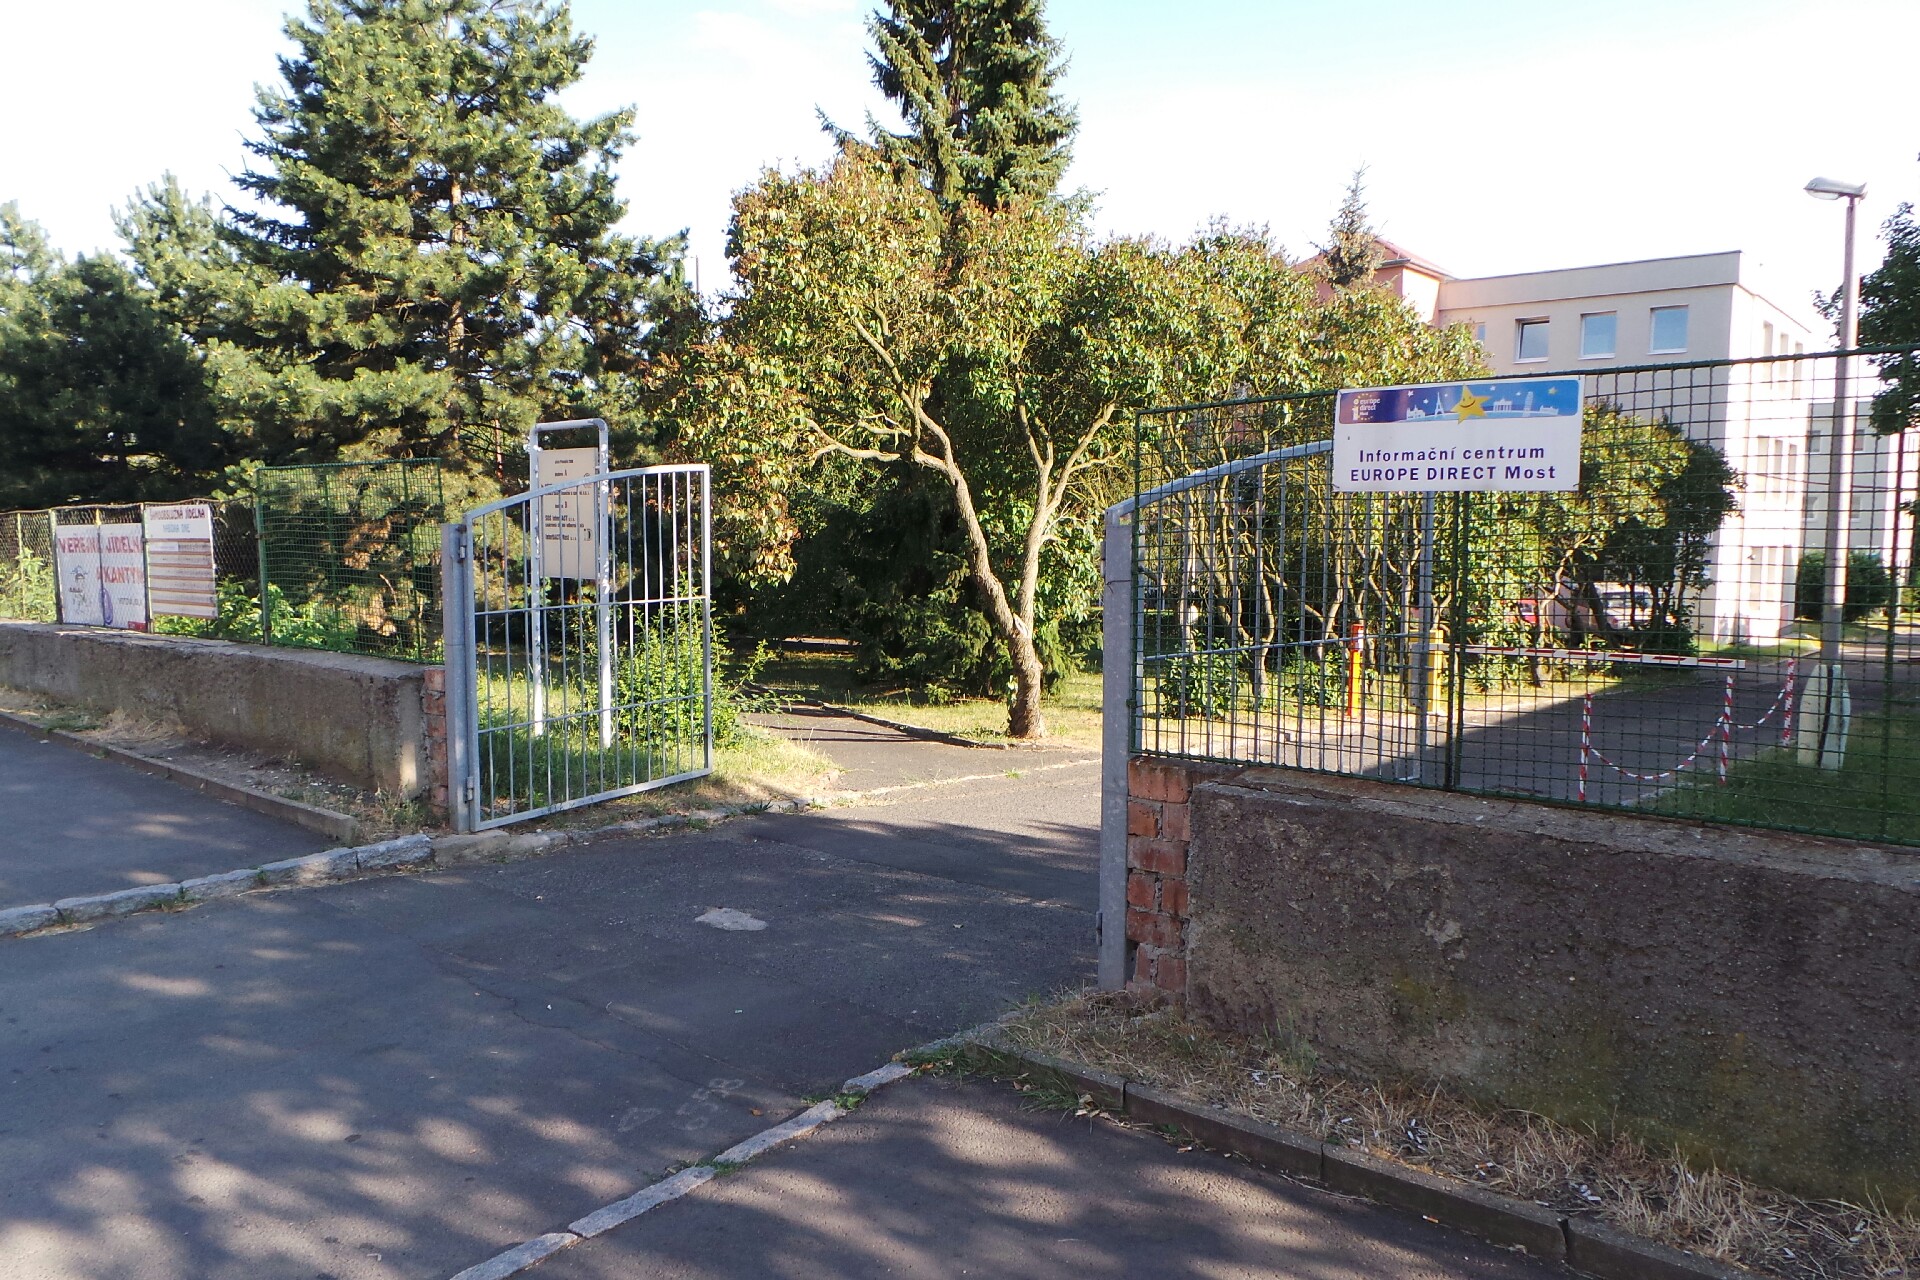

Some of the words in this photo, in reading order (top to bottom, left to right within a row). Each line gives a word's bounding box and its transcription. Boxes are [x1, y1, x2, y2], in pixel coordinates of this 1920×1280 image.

[1359, 446, 1457, 463] Informační
[1462, 446, 1545, 460] centrum
[1350, 467, 1419, 482] EUROPE
[1426, 466, 1496, 480] DIRECT
[1504, 465, 1556, 480] Most
[103, 563, 145, 585] KANTÝN
